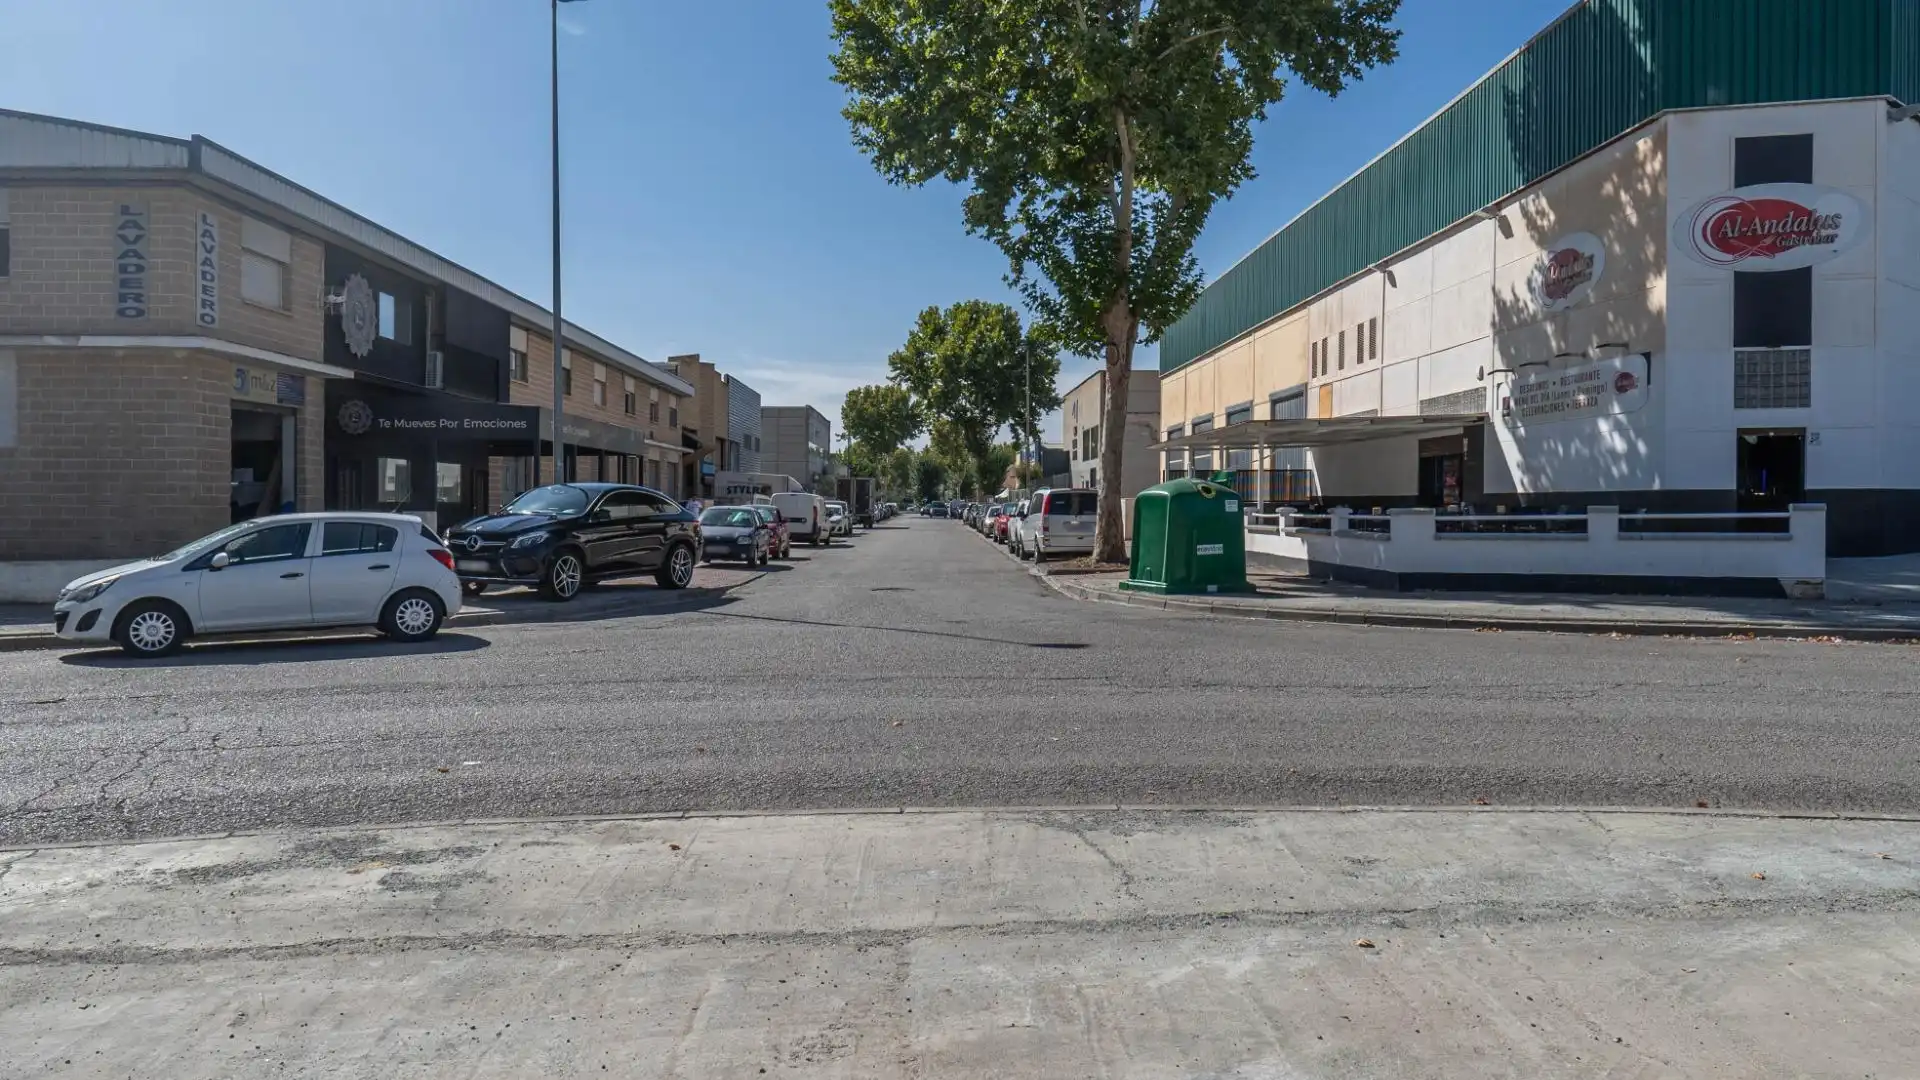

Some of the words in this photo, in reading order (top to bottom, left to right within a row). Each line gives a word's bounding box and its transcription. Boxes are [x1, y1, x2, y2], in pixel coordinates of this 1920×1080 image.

[1718, 208, 1842, 239] Al-Andalus
[117, 205, 146, 318] LAVADERO
[200, 213, 216, 325] LAVADERO
[378, 418, 391, 429] Te
[394, 418, 436, 429] Mueves
[440, 418, 458, 429] Por
[464, 418, 527, 429] Emociones
